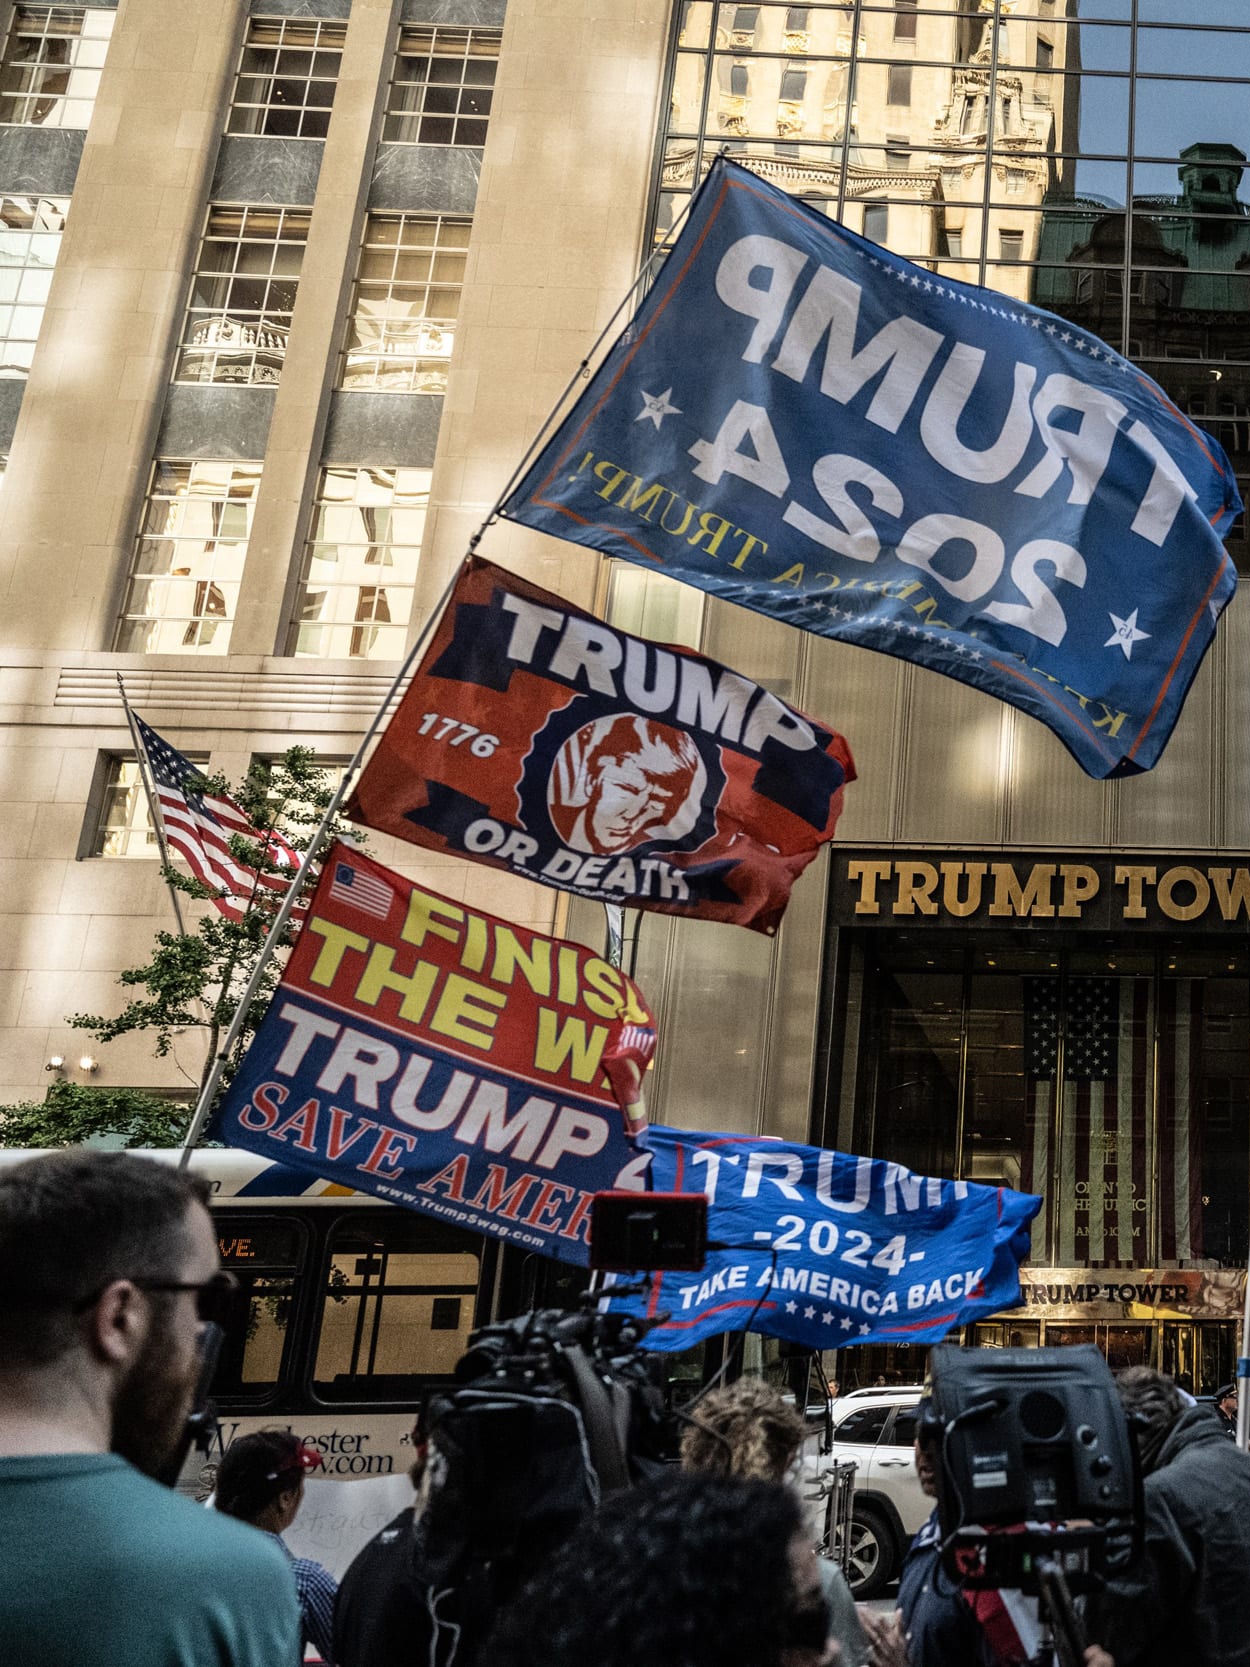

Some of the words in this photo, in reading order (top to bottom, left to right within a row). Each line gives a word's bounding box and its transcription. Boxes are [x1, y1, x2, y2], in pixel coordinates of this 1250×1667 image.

[501, 592, 817, 753] TRUMP
[420, 711, 501, 760] 1776
[463, 818, 540, 866] OR
[541, 849, 691, 902] DEATH
[847, 860, 1100, 918] TRUMP
[308, 916, 507, 1051] THE
[274, 1002, 609, 1170] TRUMP
[238, 1080, 417, 1181] SAVE
[418, 1153, 594, 1246] AMER
[376, 1181, 546, 1248] www.TrumpSwag.com
[753, 1214, 926, 1276] -2024-
[679, 1264, 750, 1310] TAKE
[756, 1266, 899, 1317] AMERICA
[906, 1266, 985, 1311] BACK
[1018, 1283, 1100, 1305] TRUMP
[1103, 1283, 1189, 1303] TOWER
